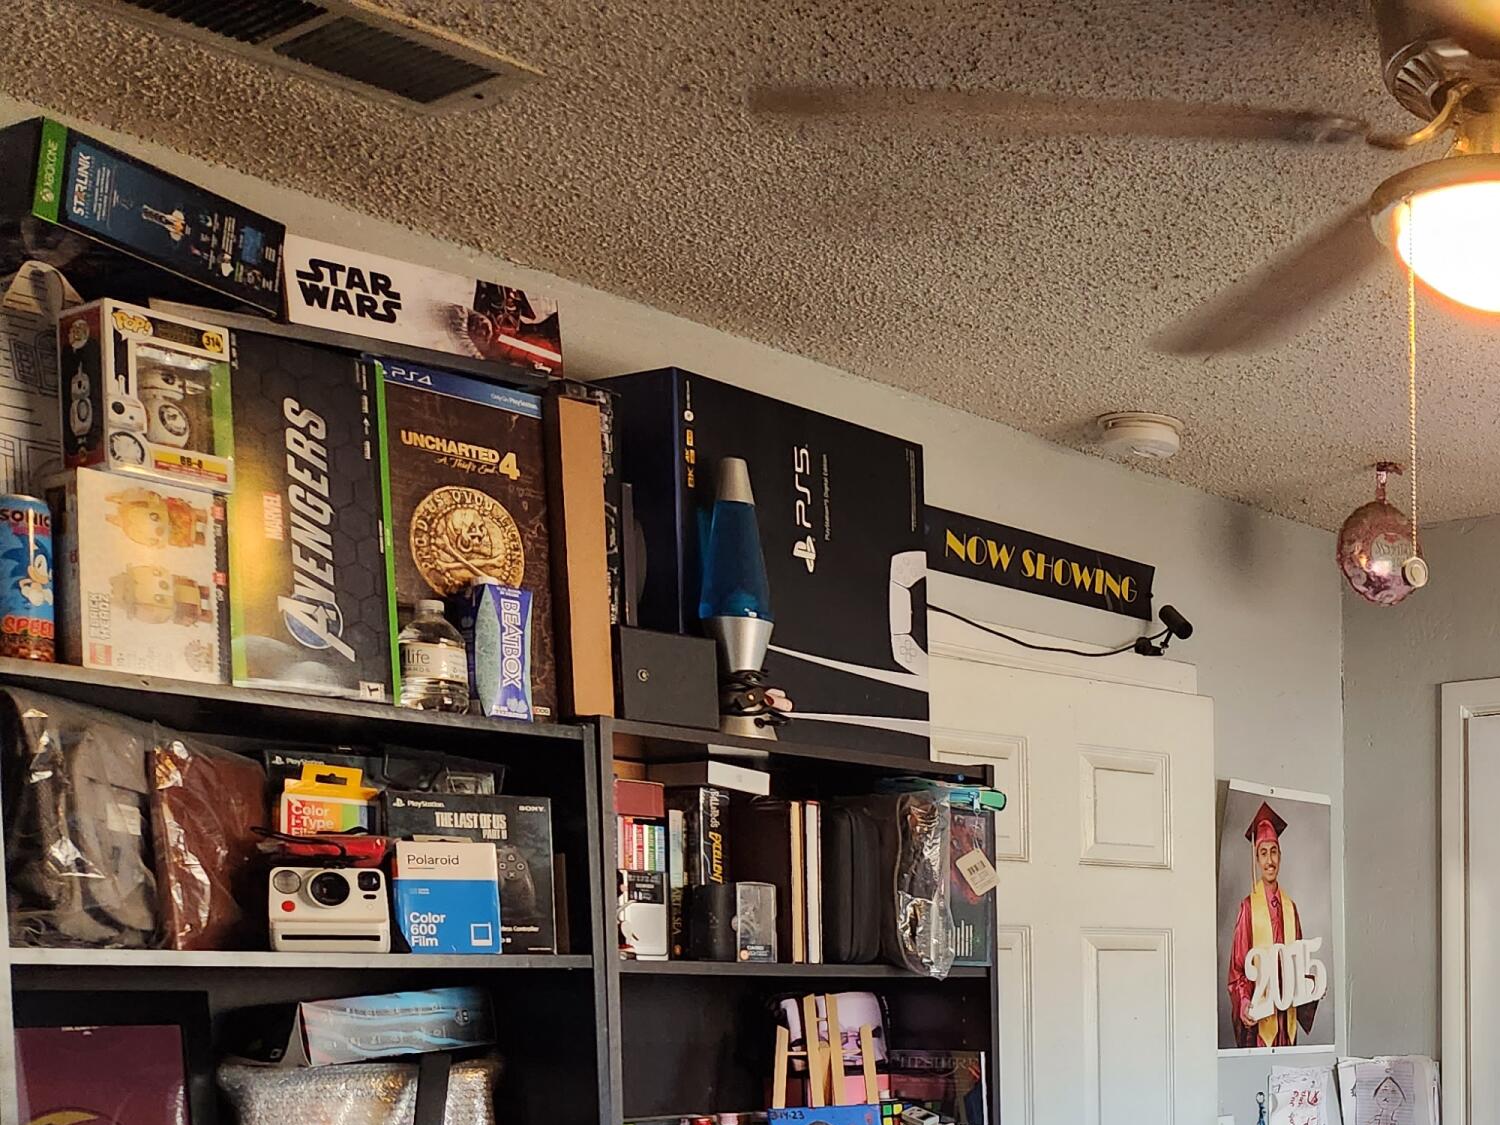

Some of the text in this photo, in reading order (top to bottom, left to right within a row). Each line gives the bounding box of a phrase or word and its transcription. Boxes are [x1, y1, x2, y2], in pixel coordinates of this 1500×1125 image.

[73, 152, 91, 217] STARLINK
[296, 258, 401, 300] STAR
[297, 280, 402, 323] WARS
[204, 333, 222, 348] 314
[391, 366, 433, 386] PS4
[401, 430, 521, 480] UNCHARTED 4
[793, 445, 812, 528] PS5
[262, 492, 284, 542] MARVEL
[277, 397, 355, 662] AVENGERS
[945, 528, 1138, 603] NOW SHOWING
[500, 598, 525, 690] BEATBOX
[291, 804, 330, 817] Color
[291, 816, 334, 830] I-Type
[434, 811, 507, 830] THE LAST OF US
[482, 829, 501, 839] PART
[407, 854, 460, 866] Polaroid
[708, 831, 723, 885] EXCELLENT
[410, 911, 446, 924] Color
[411, 923, 437, 935] 600
[411, 935, 439, 947] Film
[1244, 937, 1327, 1020] 2015
